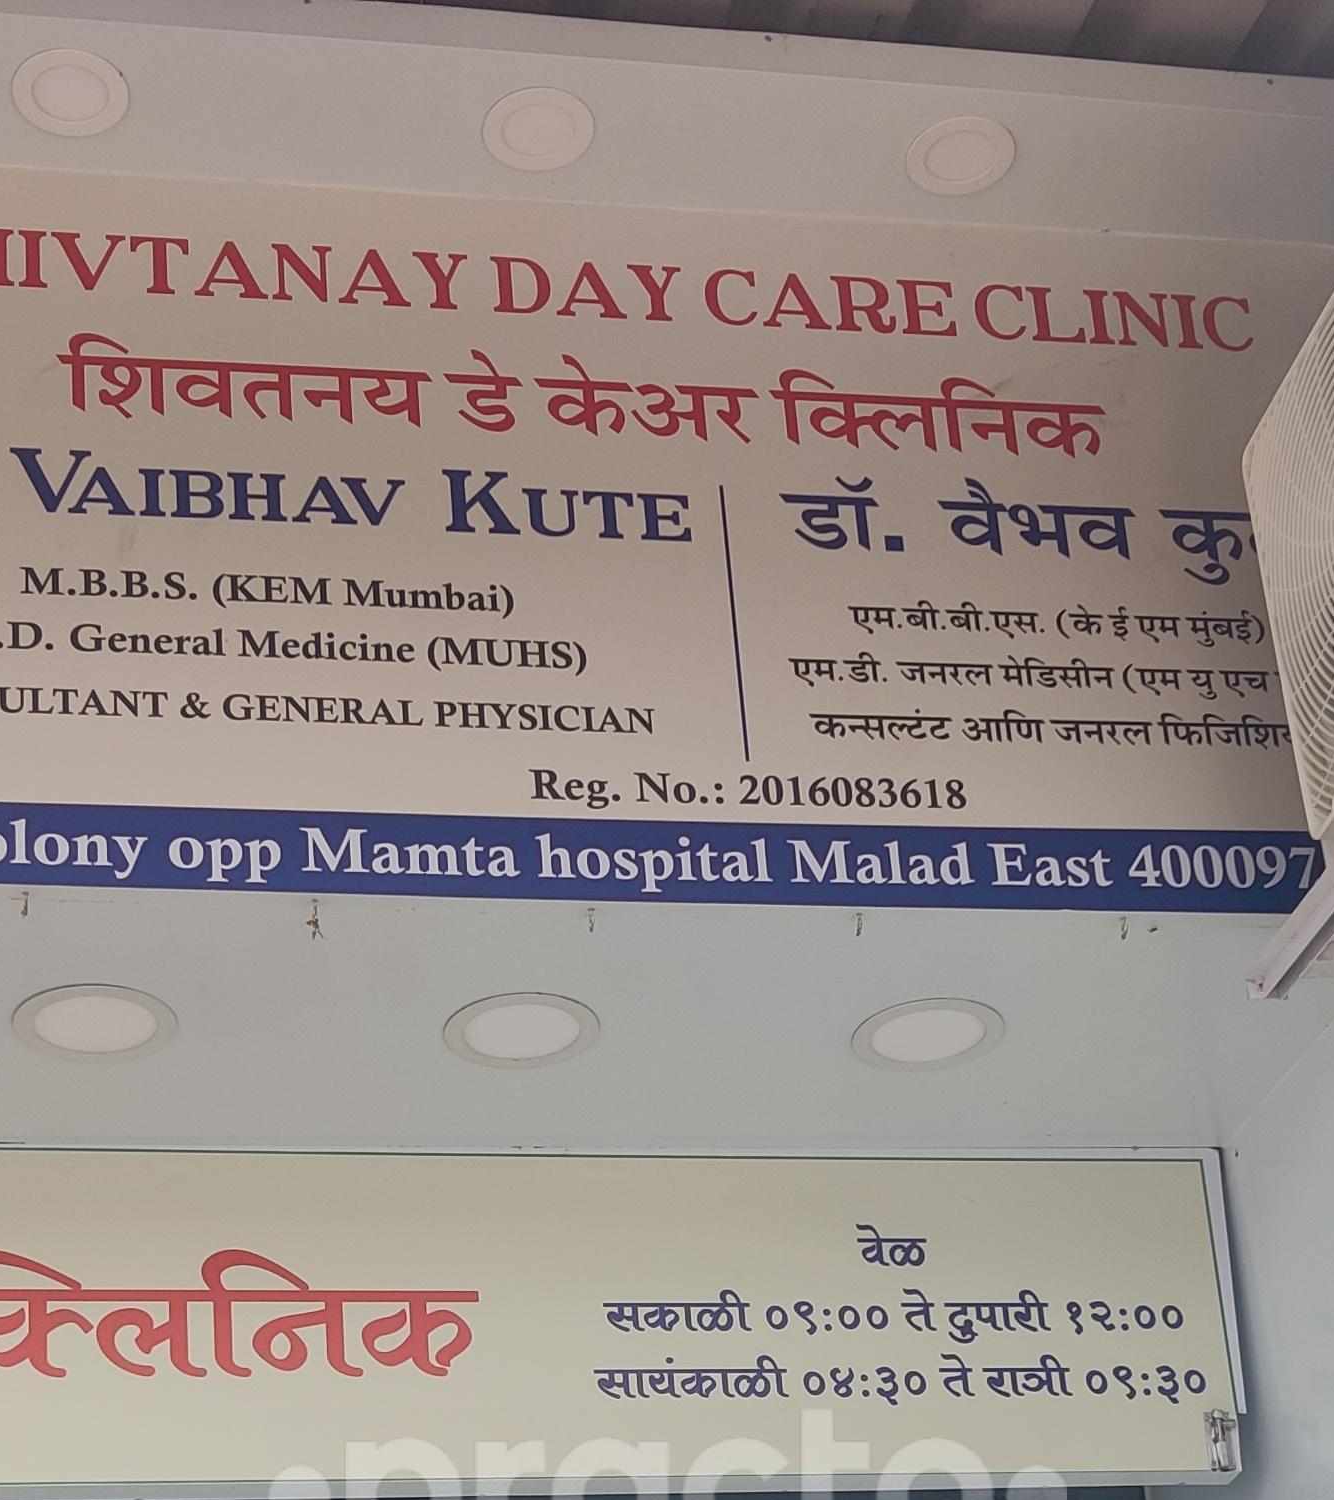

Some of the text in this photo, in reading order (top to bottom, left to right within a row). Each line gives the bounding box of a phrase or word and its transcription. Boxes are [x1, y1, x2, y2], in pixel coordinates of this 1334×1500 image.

[489, 254, 681, 322] DAY
[704, 269, 958, 337] CARE
[974, 283, 1254, 352] CLINIC
[57, 332, 1106, 458] शिवतनय डे केअर क्लिनिक
[779, 475, 905, 552] डॉ.
[937, 476, 1136, 561] वैभव
[19, 566, 515, 619] M.B.B.S. (KEM Mumbai)
[70, 622, 227, 658] General
[237, 627, 415, 664] Medicine
[427, 635, 588, 677] (MUHS)
[848, 600, 1265, 647] एम.बी.बी.एस. (के ई एम मुंबई)
[788, 651, 1269, 700] एम.डी. जनरल मेडिसीन (एम यु एच
[180, 692, 211, 721] &
[222, 692, 424, 729] GENERAL
[434, 701, 655, 736] PHYSICIAN
[809, 708, 952, 741] कन्सल्टंट
[963, 709, 1045, 743] आणि
[1050, 719, 1152, 746] जनरल
[529, 769, 968, 811] Reg. No.: 2016083618
[169, 834, 281, 884] opp
[300, 827, 519, 879] Mamta
[536, 832, 769, 894] hospital
[791, 837, 972, 889] Malad
[987, 842, 1113, 890] East
[1129, 844, 1318, 891] 400097
[856, 1223, 926, 1267] वेळ
[604, 1288, 1184, 1342] सकाळी ०९:०० ते दुपारी १२:००
[594, 1354, 1206, 1405] सायंकाळी ०४:३० ते रात्री ०९:३०
